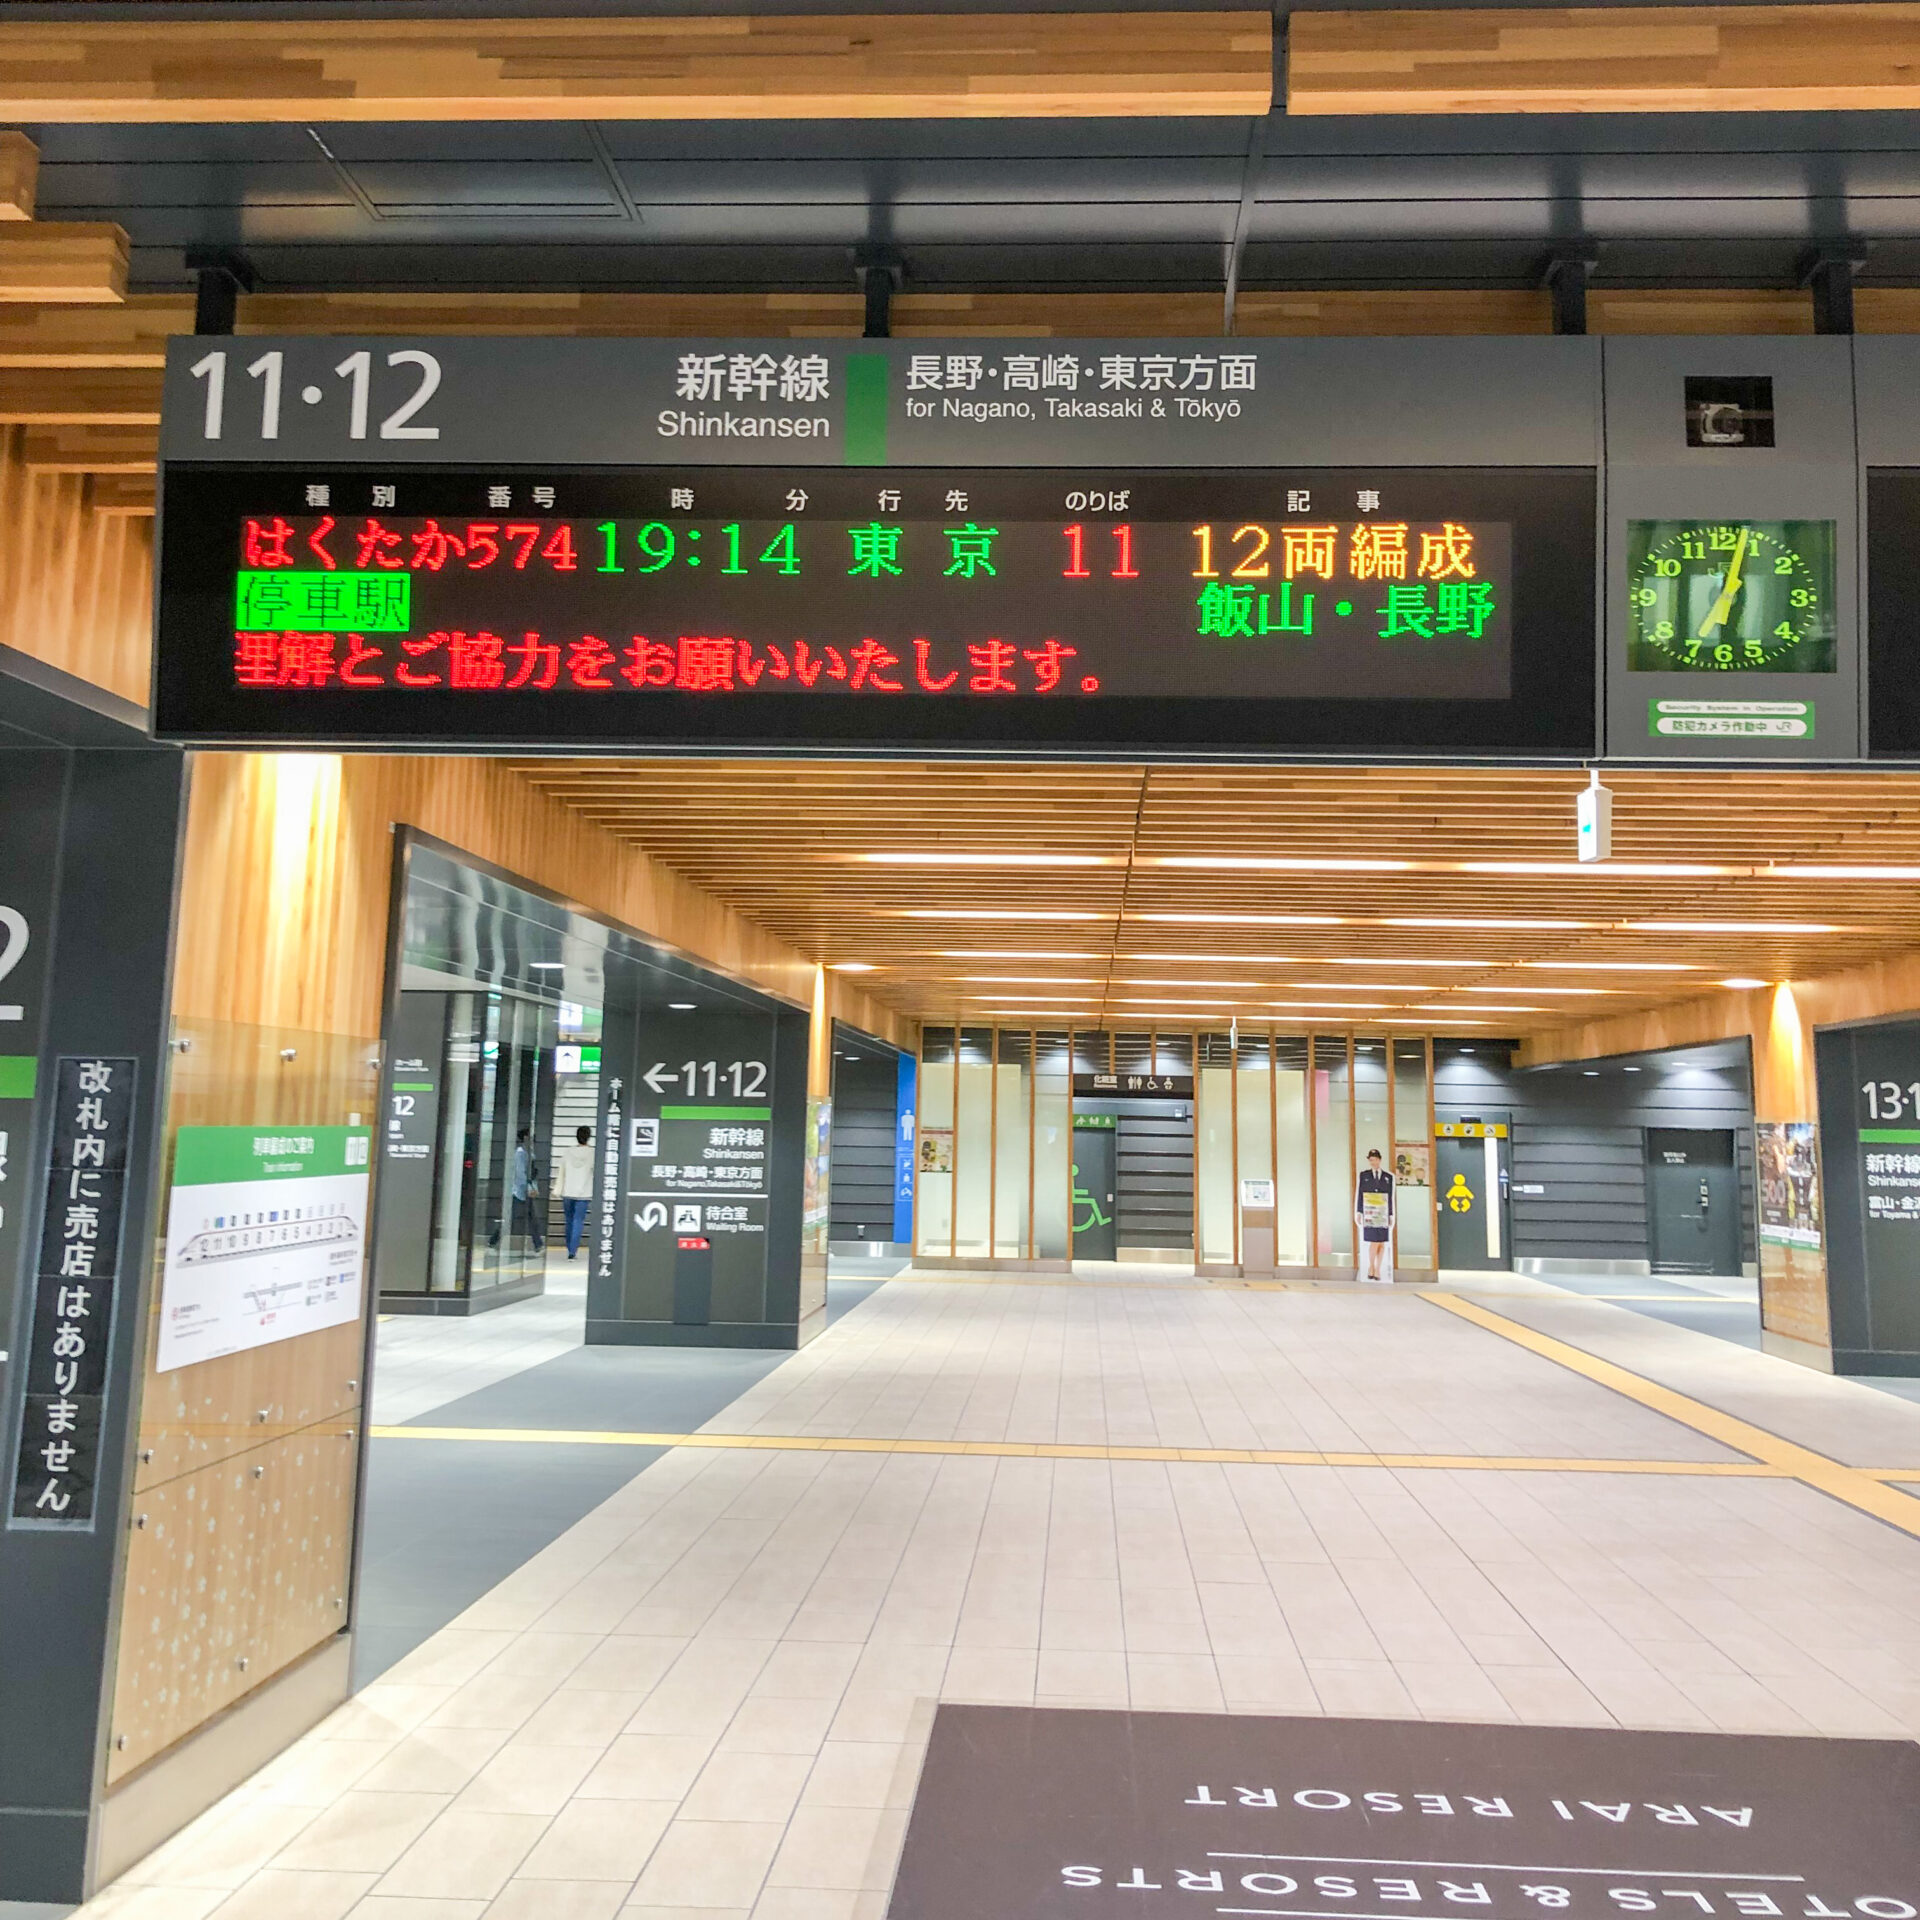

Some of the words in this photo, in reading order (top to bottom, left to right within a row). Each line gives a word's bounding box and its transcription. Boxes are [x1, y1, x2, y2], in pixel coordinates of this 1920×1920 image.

[676, 353, 829, 403] 新幹線
[906, 398, 936, 417] for
[943, 399, 1036, 423] Nagano,
[1044, 398, 1142, 418] Takasaki
[1150, 399, 1166, 418] &
[1174, 398, 1241, 423] Tōkyō
[657, 410, 829, 439] Shinkansen
[1065, 491, 1130, 511] のりば
[596, 521, 801, 575] 19:14
[1682, 541, 1706, 559] 11
[1709, 533, 1737, 550] 12
[1748, 539, 1760, 557] 1
[1063, 524, 1139, 578] 11
[1654, 559, 1682, 577] 10
[1774, 556, 1793, 575] 2
[242, 575, 407, 628] 停車駅
[1639, 588, 1657, 606] 9
[1790, 589, 1809, 608] 3
[1655, 621, 1674, 639] 8
[1773, 621, 1793, 639] 4
[1685, 640, 1703, 658] 7
[1714, 644, 1733, 662] 6
[1744, 640, 1763, 658] 5
[709, 1128, 764, 1146] 新幹線
[703, 1148, 764, 1160] Shinkansen
[705, 1206, 748, 1221] 待合室
[705, 1222, 738, 1233] Waiting
[738, 1222, 764, 1232] Room
[36, 1061, 113, 1511] 改札内に売店はありません
[1184, 1785, 1514, 1818] RESORT
[1551, 1799, 1753, 1828] ARAI
[1061, 1865, 1492, 1904] RESORTS
[1519, 1884, 1571, 1908] &
